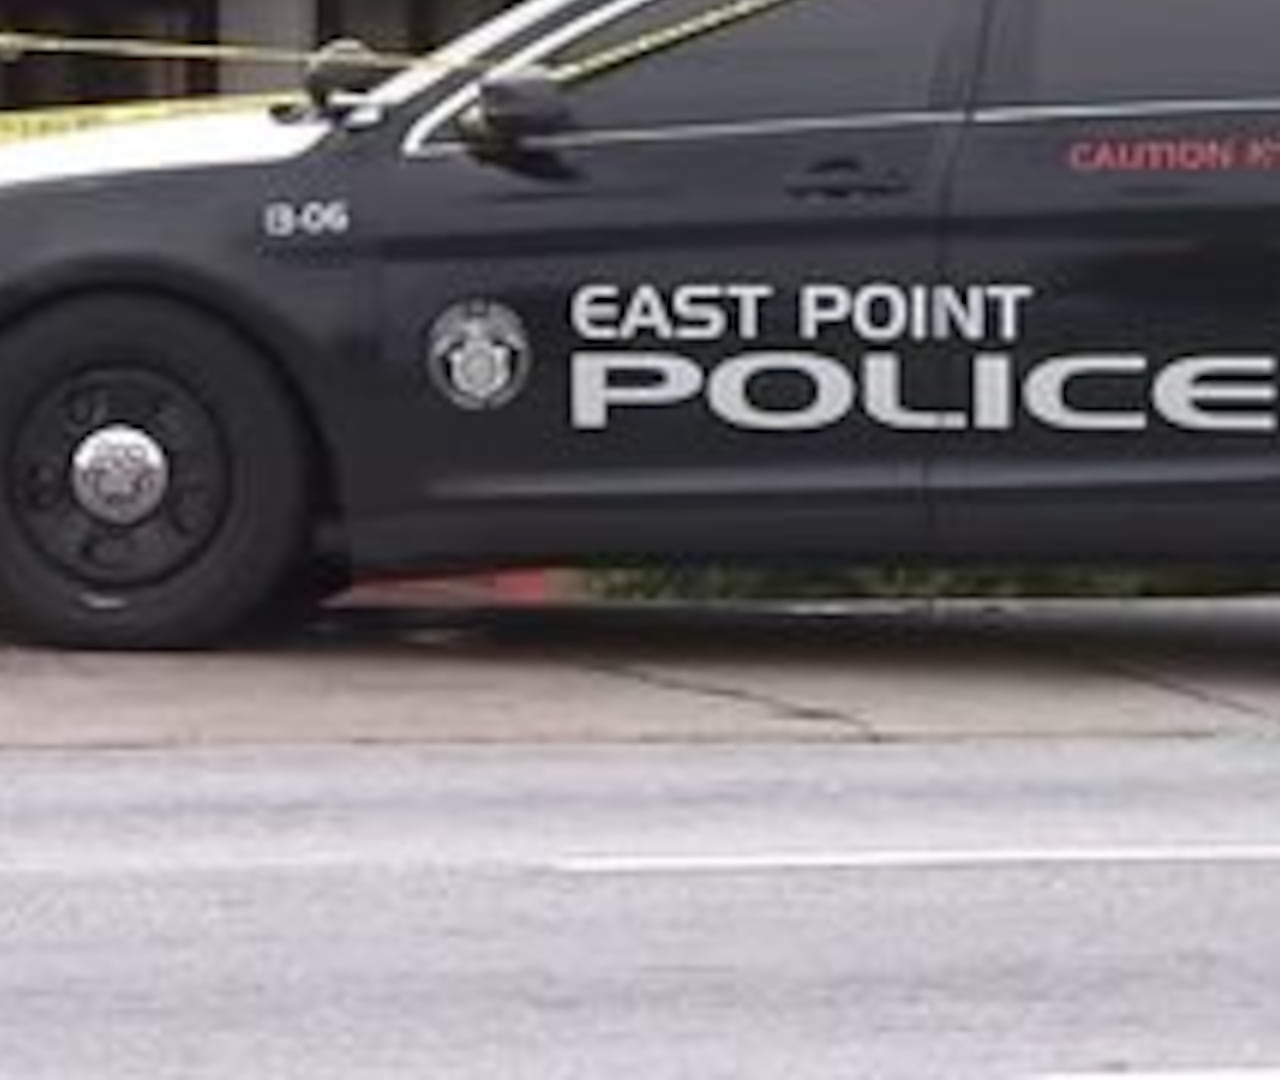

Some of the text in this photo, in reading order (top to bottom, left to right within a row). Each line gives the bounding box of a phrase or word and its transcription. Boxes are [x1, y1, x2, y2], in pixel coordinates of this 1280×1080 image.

[1069, 137, 1230, 170] CAUTION
[570, 283, 1035, 341] EAST POINT
[569, 350, 1280, 432] POLICE
